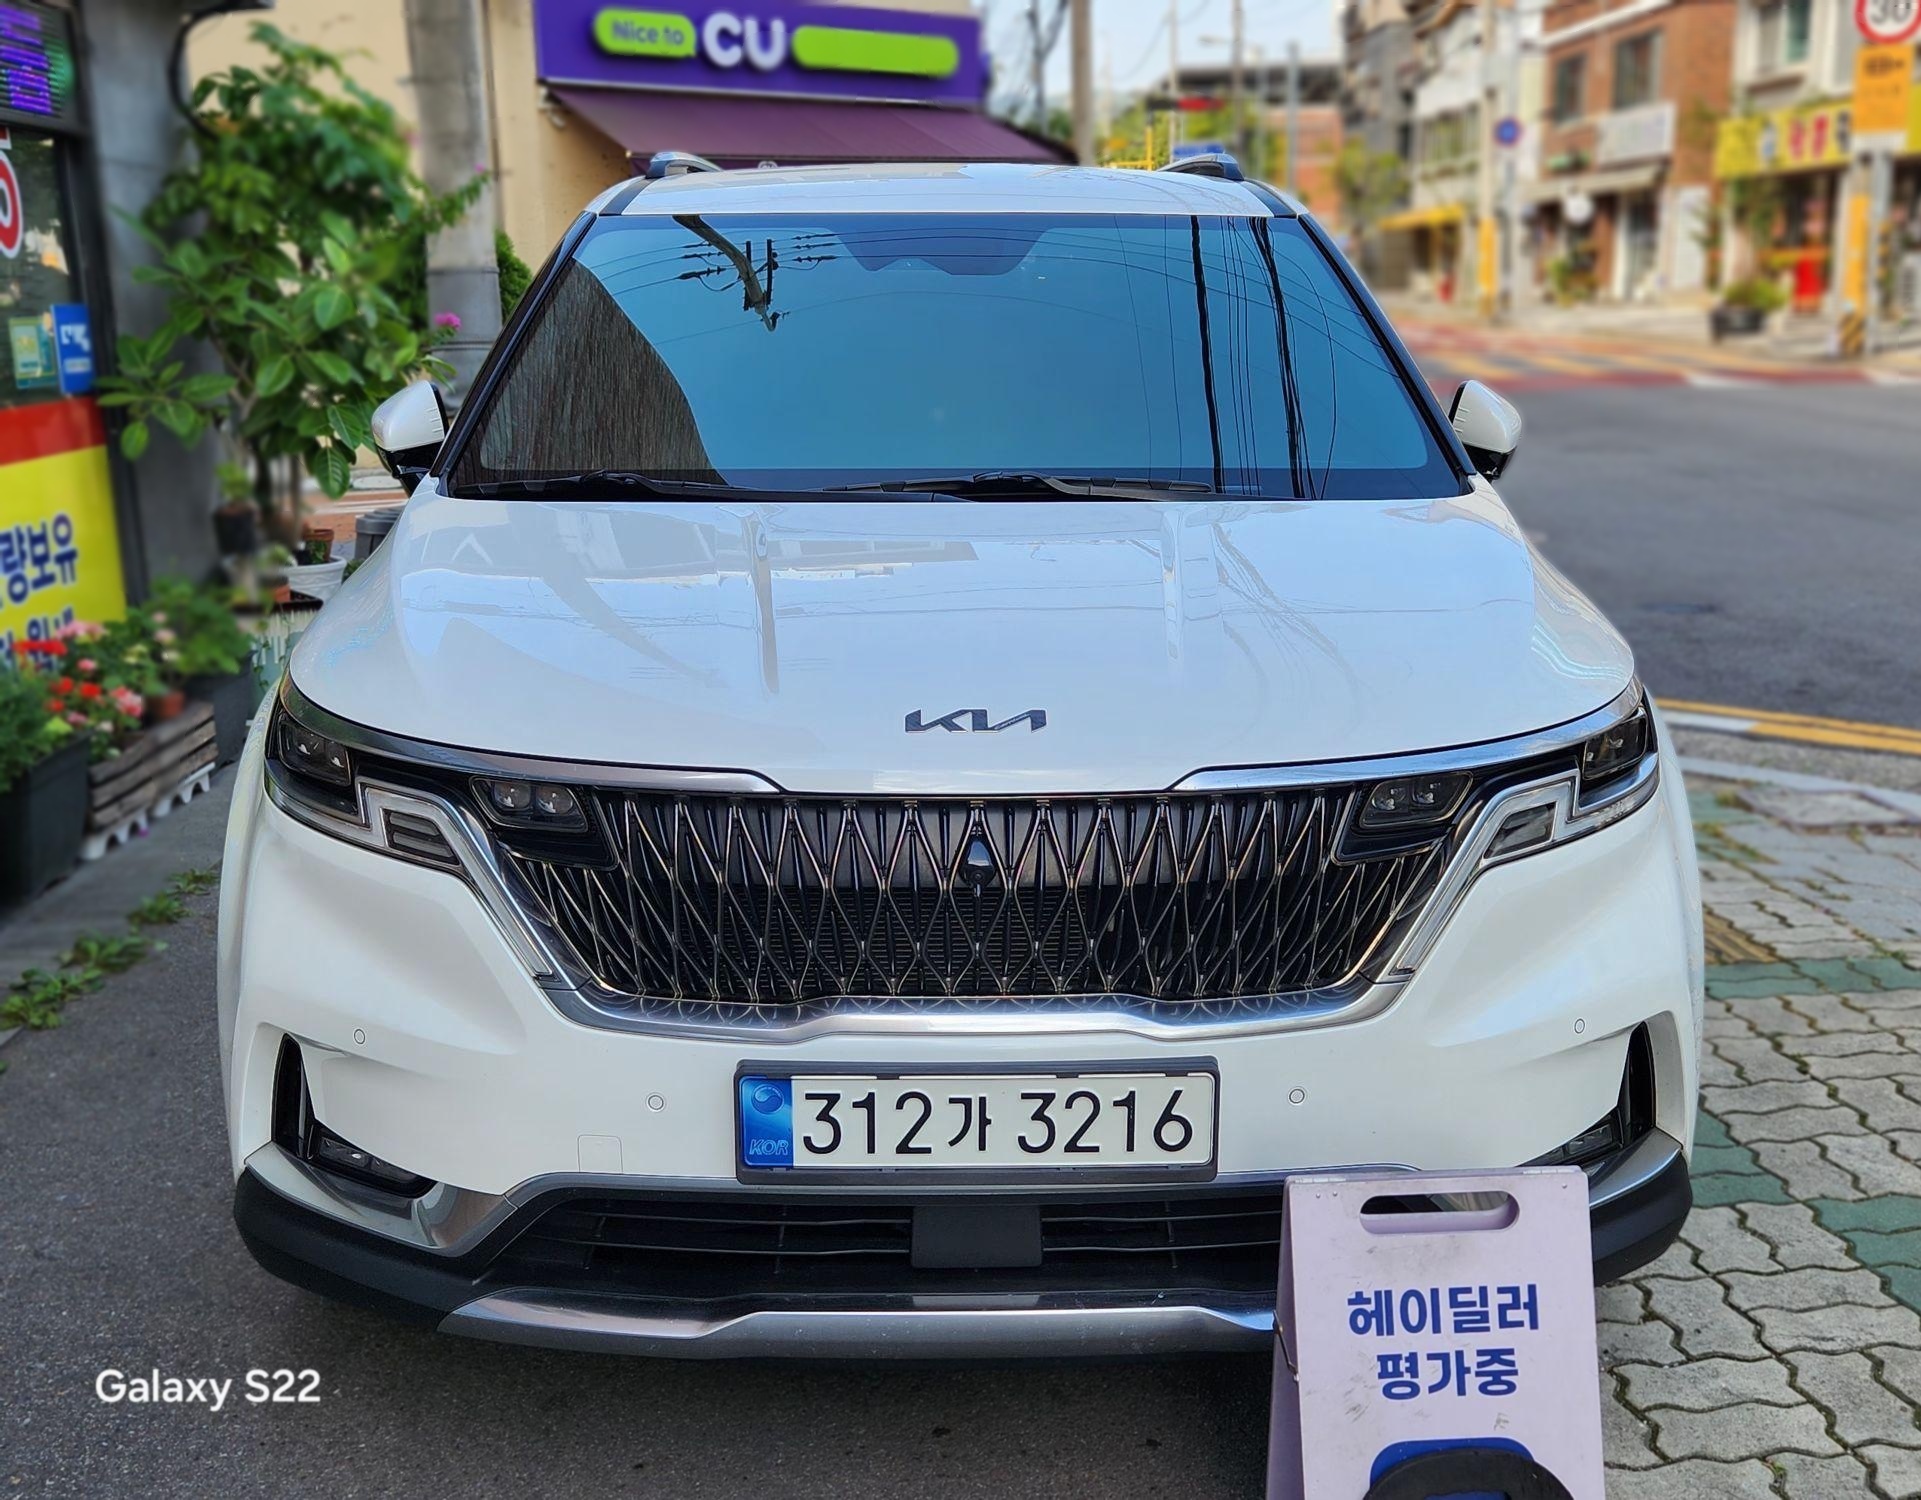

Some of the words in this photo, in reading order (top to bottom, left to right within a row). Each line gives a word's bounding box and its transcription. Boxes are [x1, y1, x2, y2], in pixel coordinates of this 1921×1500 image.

[1871, 0, 1914, 25] 30
[612, 20, 659, 43] Nice
[663, 27, 685, 46] to
[702, 11, 787, 71] CU
[0, 513, 78, 609] 량보유
[748, 1139, 790, 1156] KOR
[802, 1091, 992, 1155] 312가
[1017, 1089, 1194, 1154] 3216
[1347, 1283, 1539, 1337] 헤이딜러
[1377, 1347, 1519, 1400] 평가중
